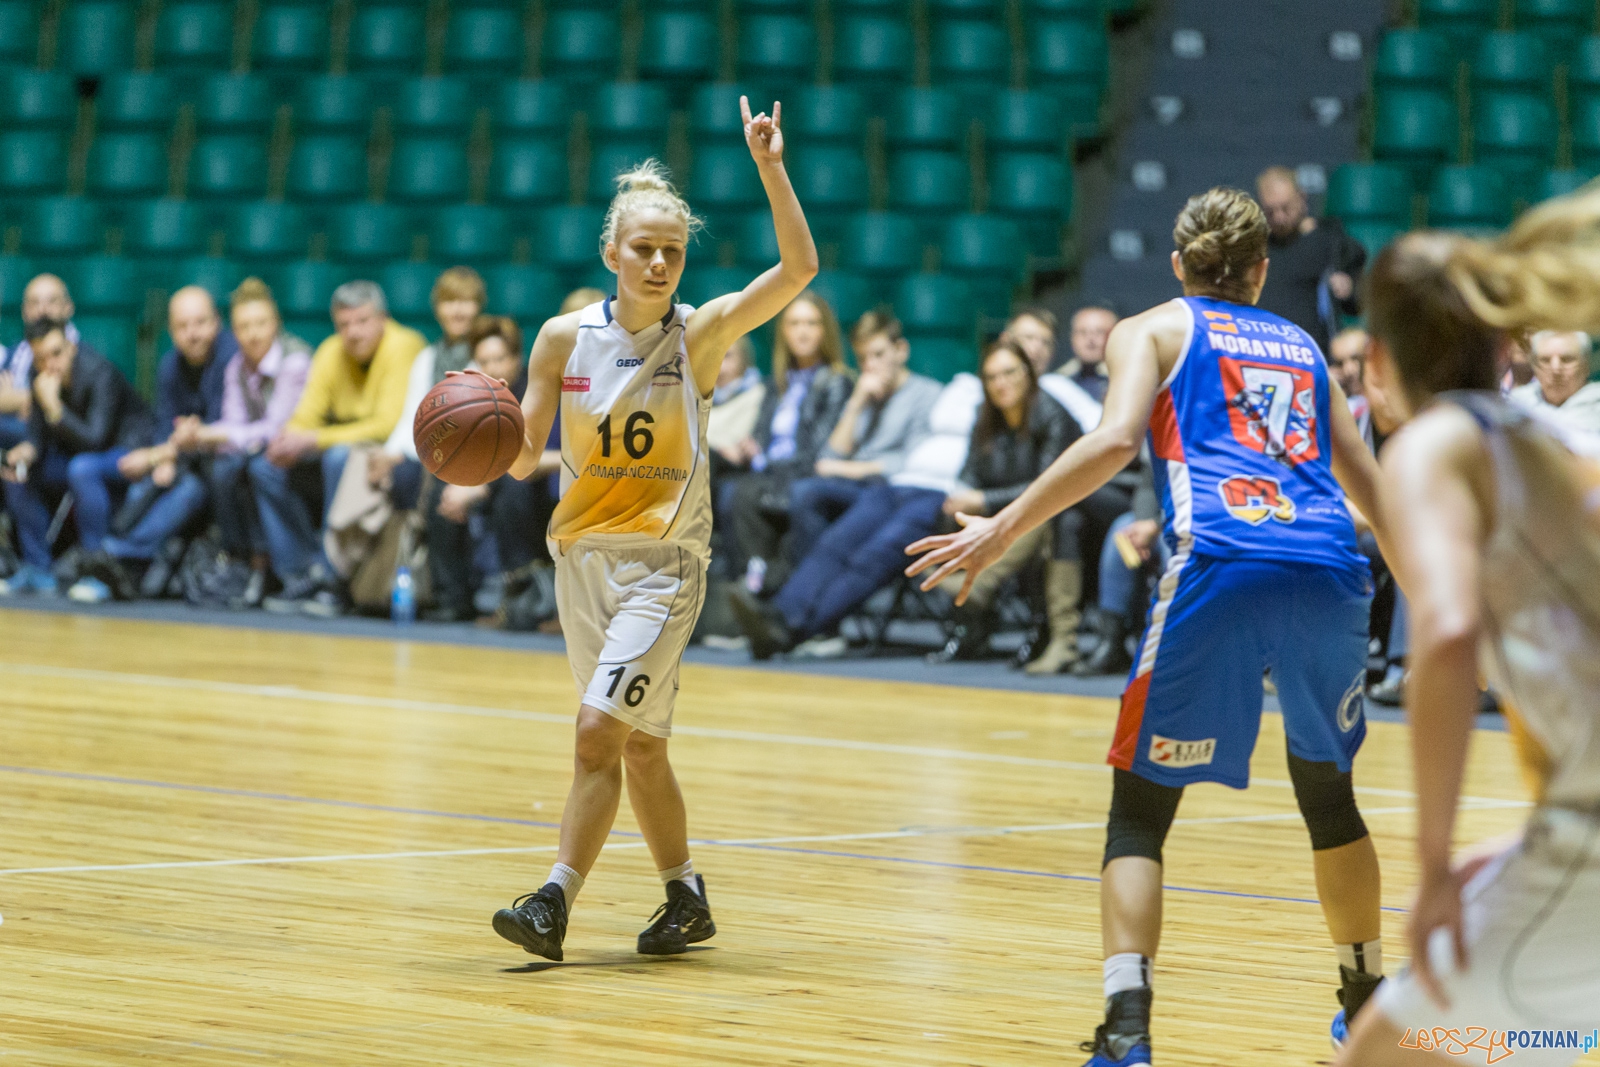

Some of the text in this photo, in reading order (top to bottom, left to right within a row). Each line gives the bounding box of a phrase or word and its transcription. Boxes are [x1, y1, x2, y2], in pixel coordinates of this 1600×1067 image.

[597, 410, 655, 460] 16
[1240, 366, 1294, 456] 7
[605, 665, 651, 708] 16
